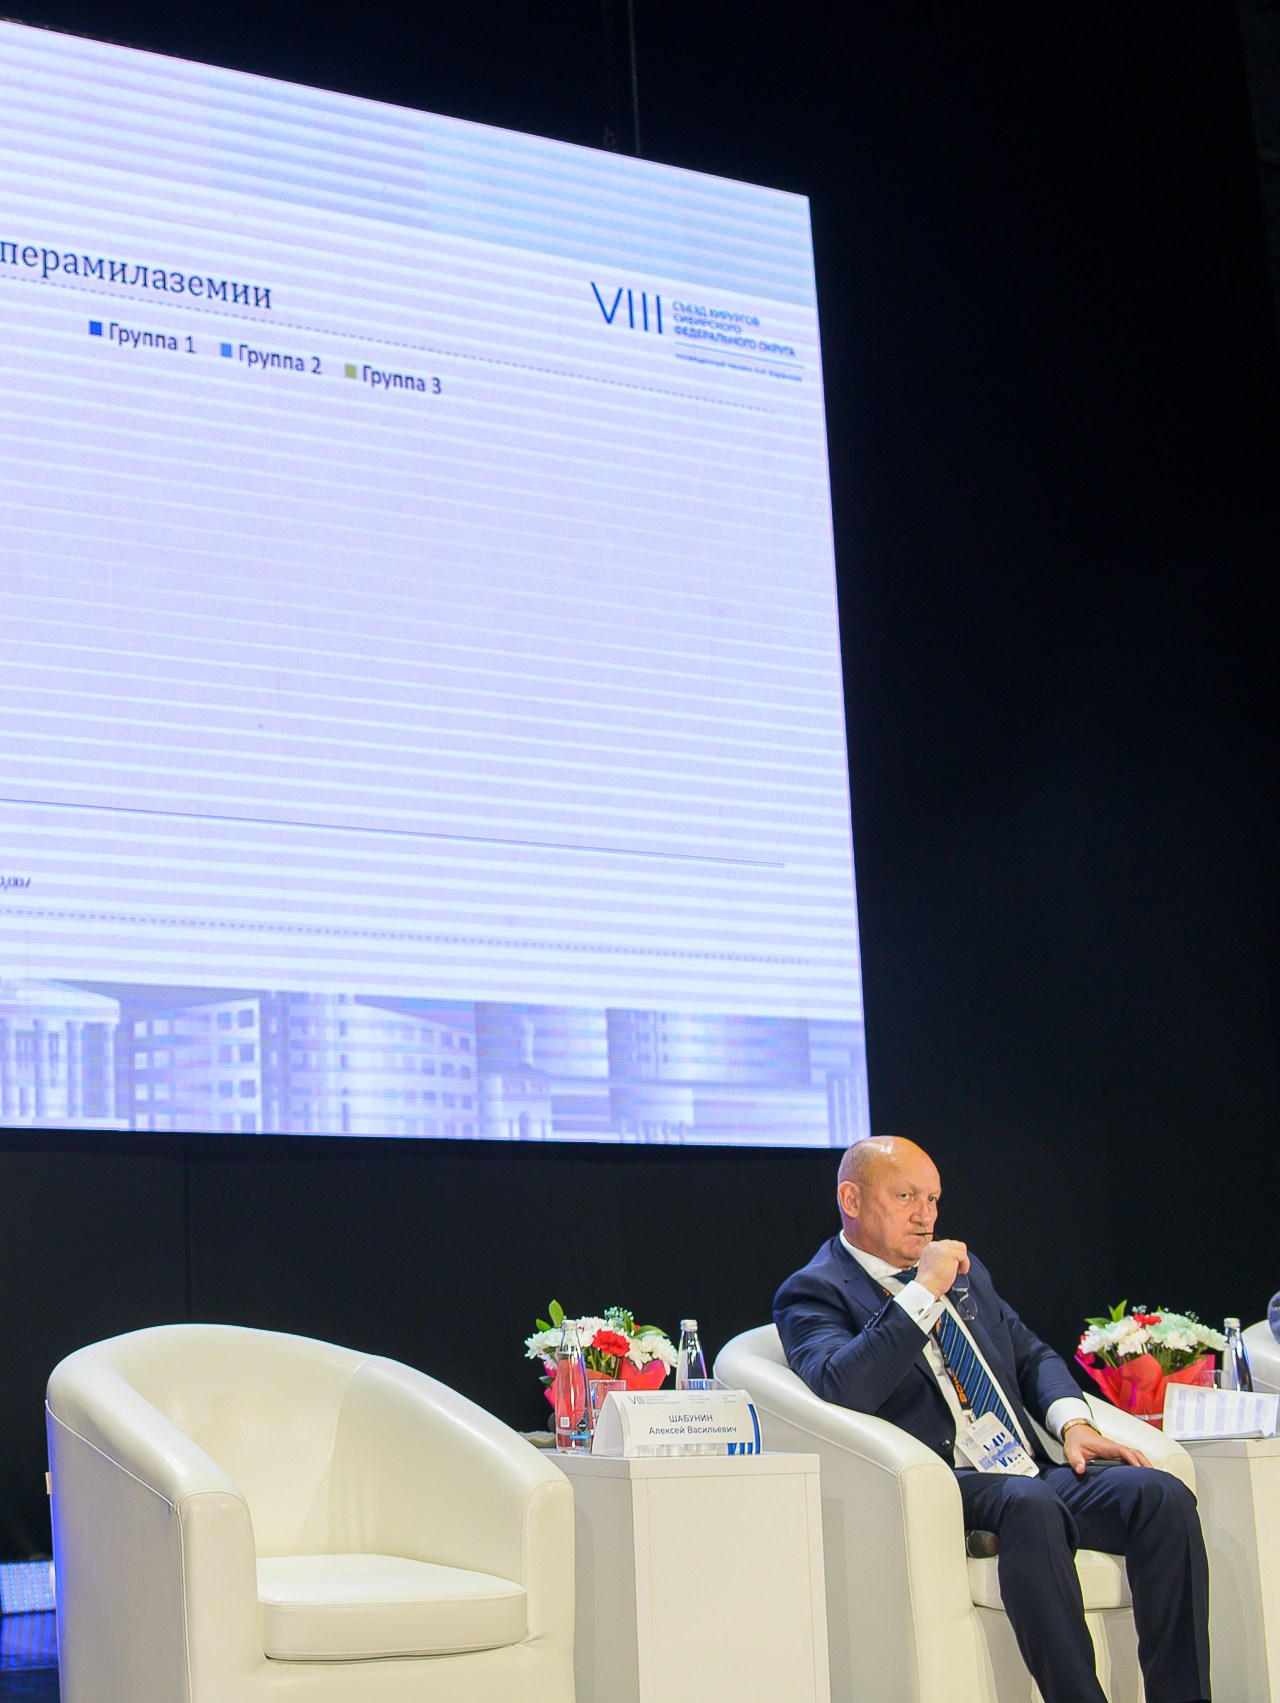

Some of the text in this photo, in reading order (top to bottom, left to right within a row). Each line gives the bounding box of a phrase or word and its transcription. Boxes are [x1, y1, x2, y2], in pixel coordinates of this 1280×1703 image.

[591, 281, 663, 335] VIII
[109, 322, 196, 354] Группа 1
[238, 344, 322, 375] Группа 2
[362, 365, 442, 395] Группа 3
[649, 1425, 737, 1435] Алексей Васильевич
[668, 1414, 713, 1423] ШАБУНИН
